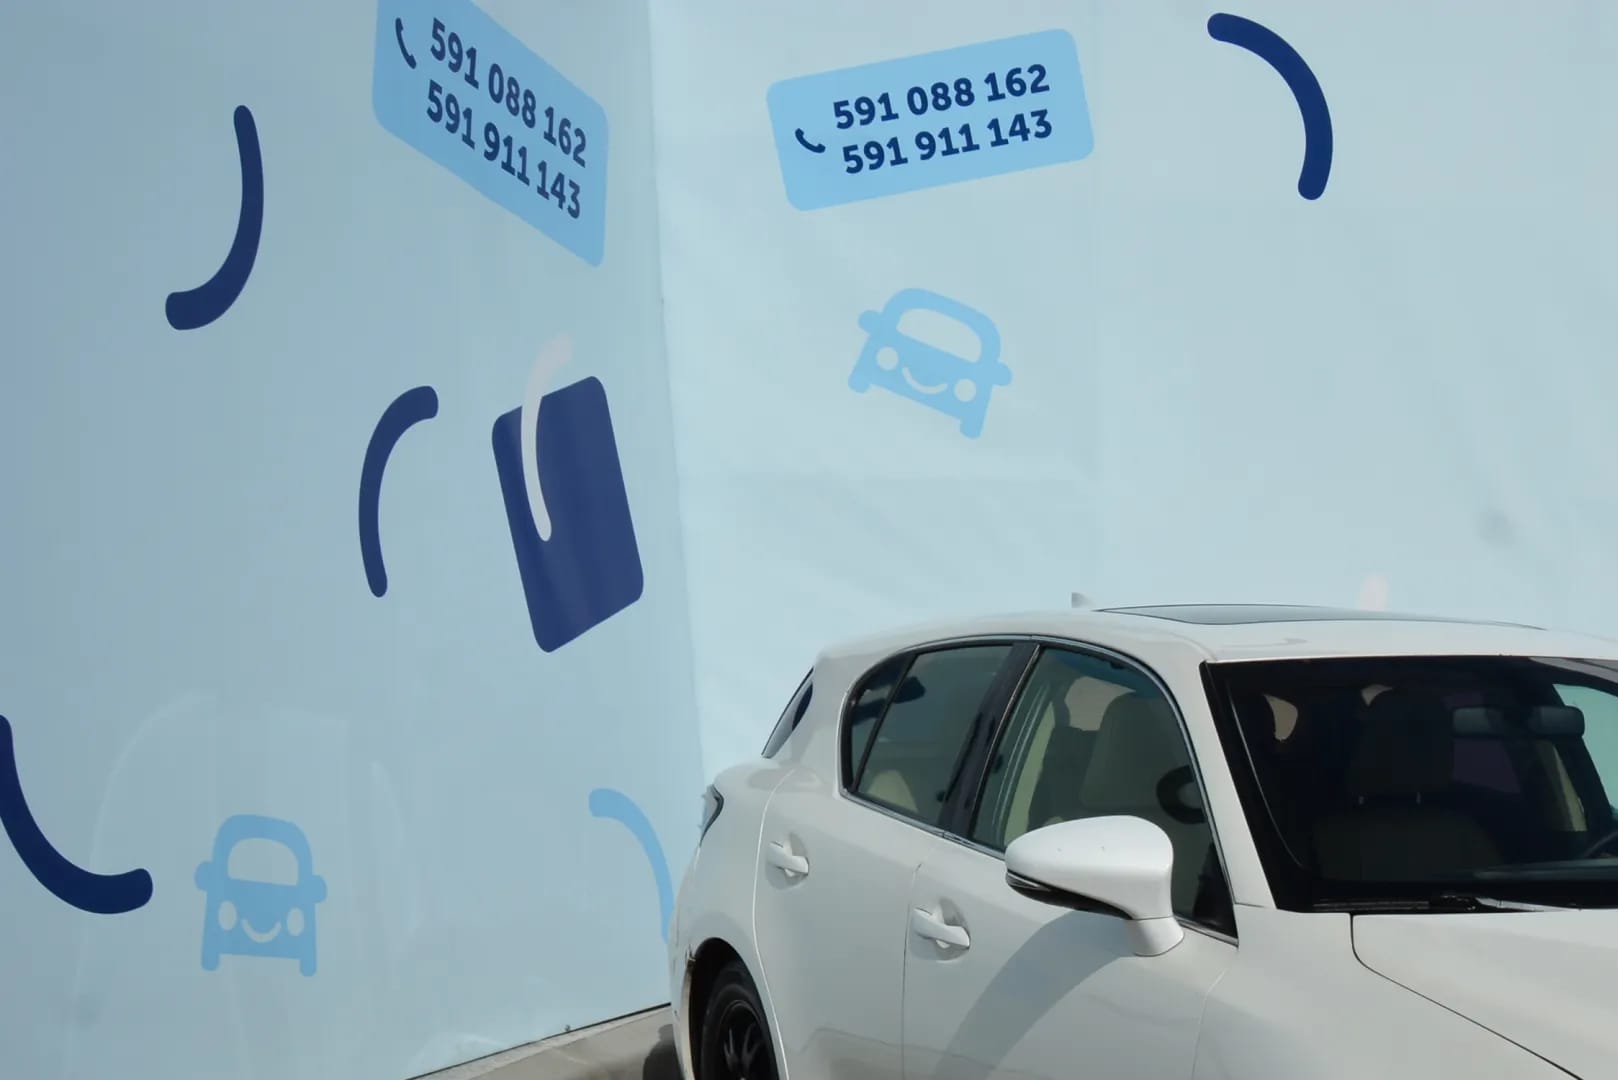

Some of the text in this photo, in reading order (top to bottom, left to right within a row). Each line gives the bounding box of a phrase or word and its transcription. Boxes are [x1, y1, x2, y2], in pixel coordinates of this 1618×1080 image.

[429, 17, 587, 169] 591 088 162
[834, 63, 1050, 130] 591 088 162
[842, 108, 1053, 175] 591 911 143
[425, 78, 582, 220] 591 911 143
